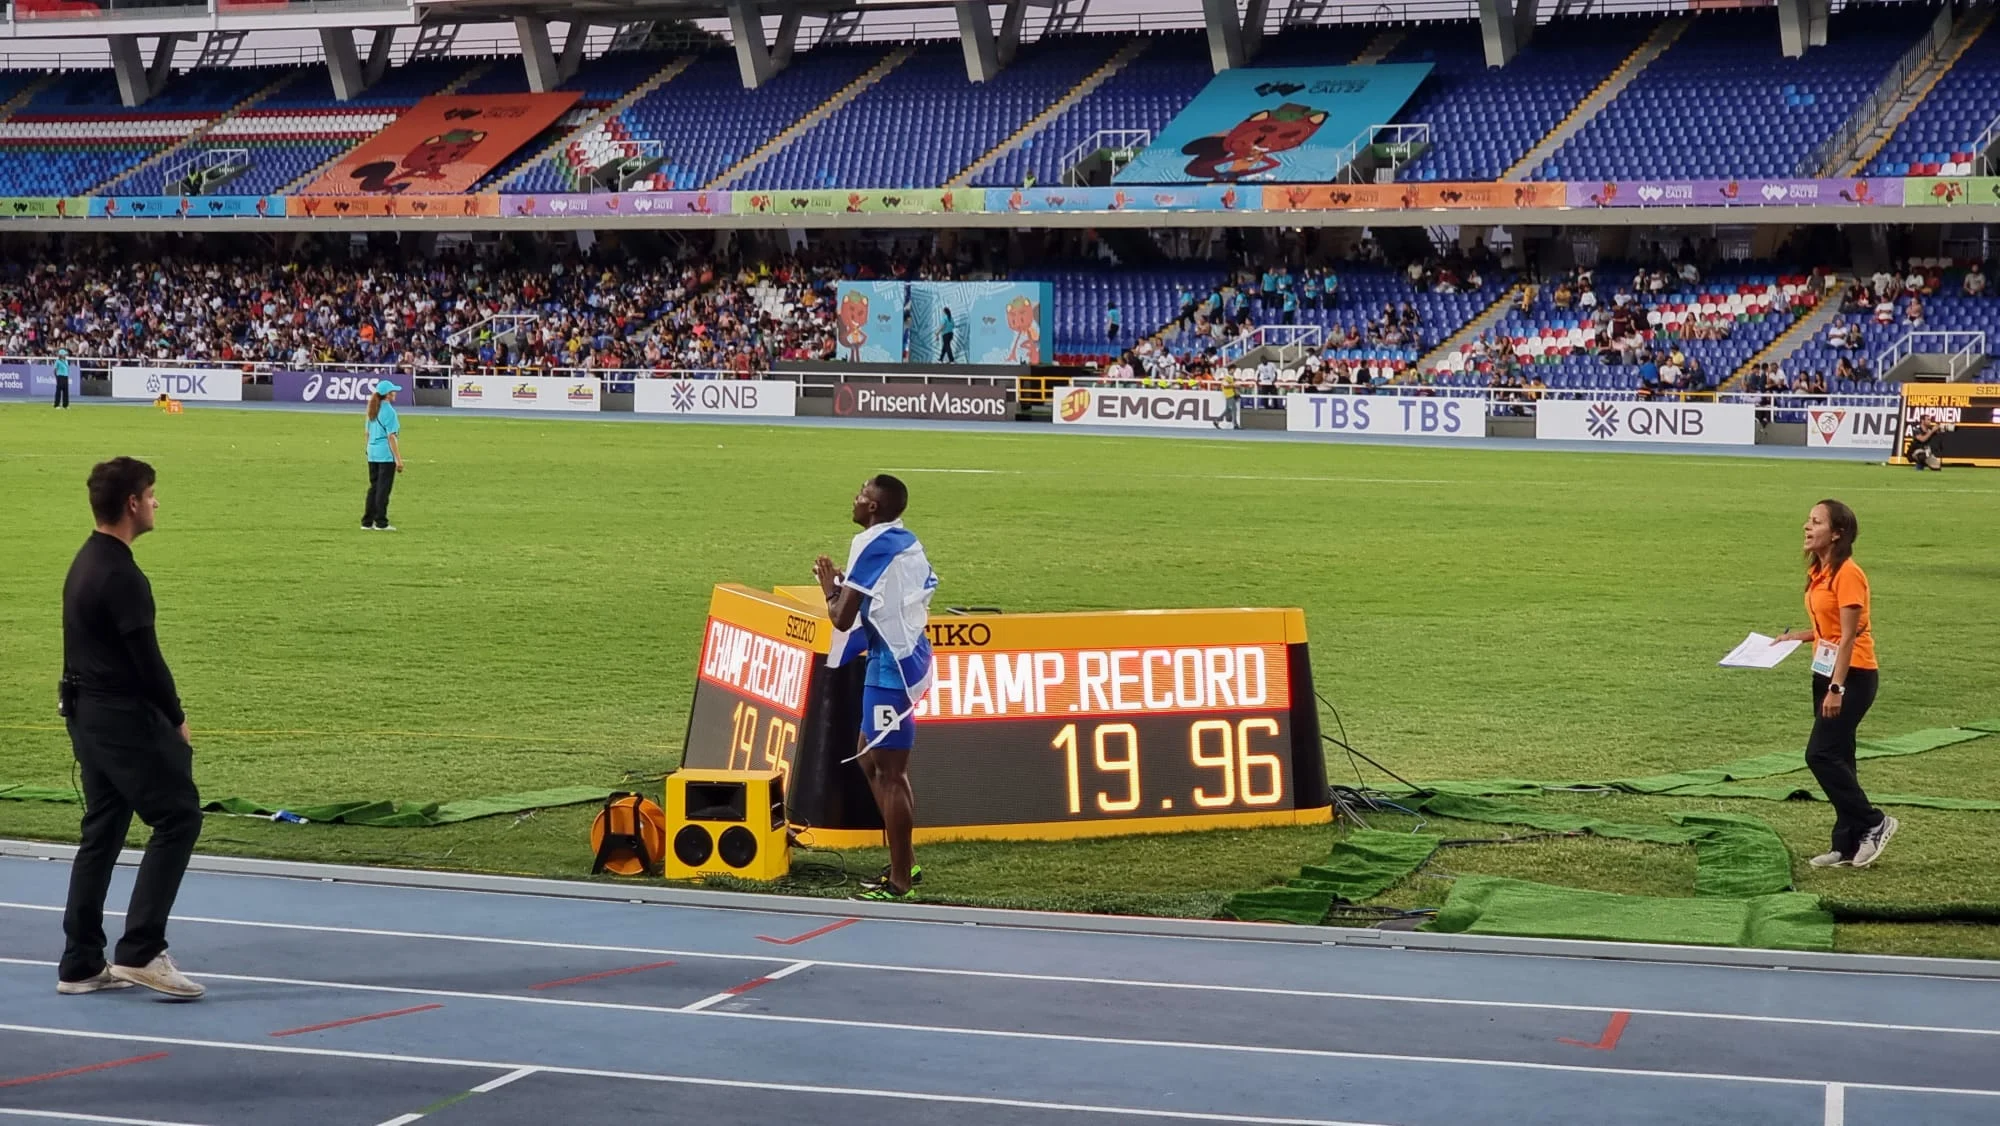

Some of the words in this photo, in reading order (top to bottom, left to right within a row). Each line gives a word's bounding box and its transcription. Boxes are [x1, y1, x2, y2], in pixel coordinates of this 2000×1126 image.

[5, 380, 23, 389] todos
[161, 374, 207, 394] TDK
[702, 385, 758, 408] QNB
[858, 389, 926, 412] Pinsent
[929, 391, 1005, 415] Masons
[1097, 395, 1232, 422] EMCAL
[1309, 397, 1370, 430] TBS
[1399, 400, 1461, 433] TBS
[1906, 407, 1961, 422] LAMPINEN
[1628, 407, 1704, 435] QNB
[785, 615, 816, 643] SEIKO
[914, 646, 1267, 717] HAMP.RECORD
[882, 709, 894, 727] 5
